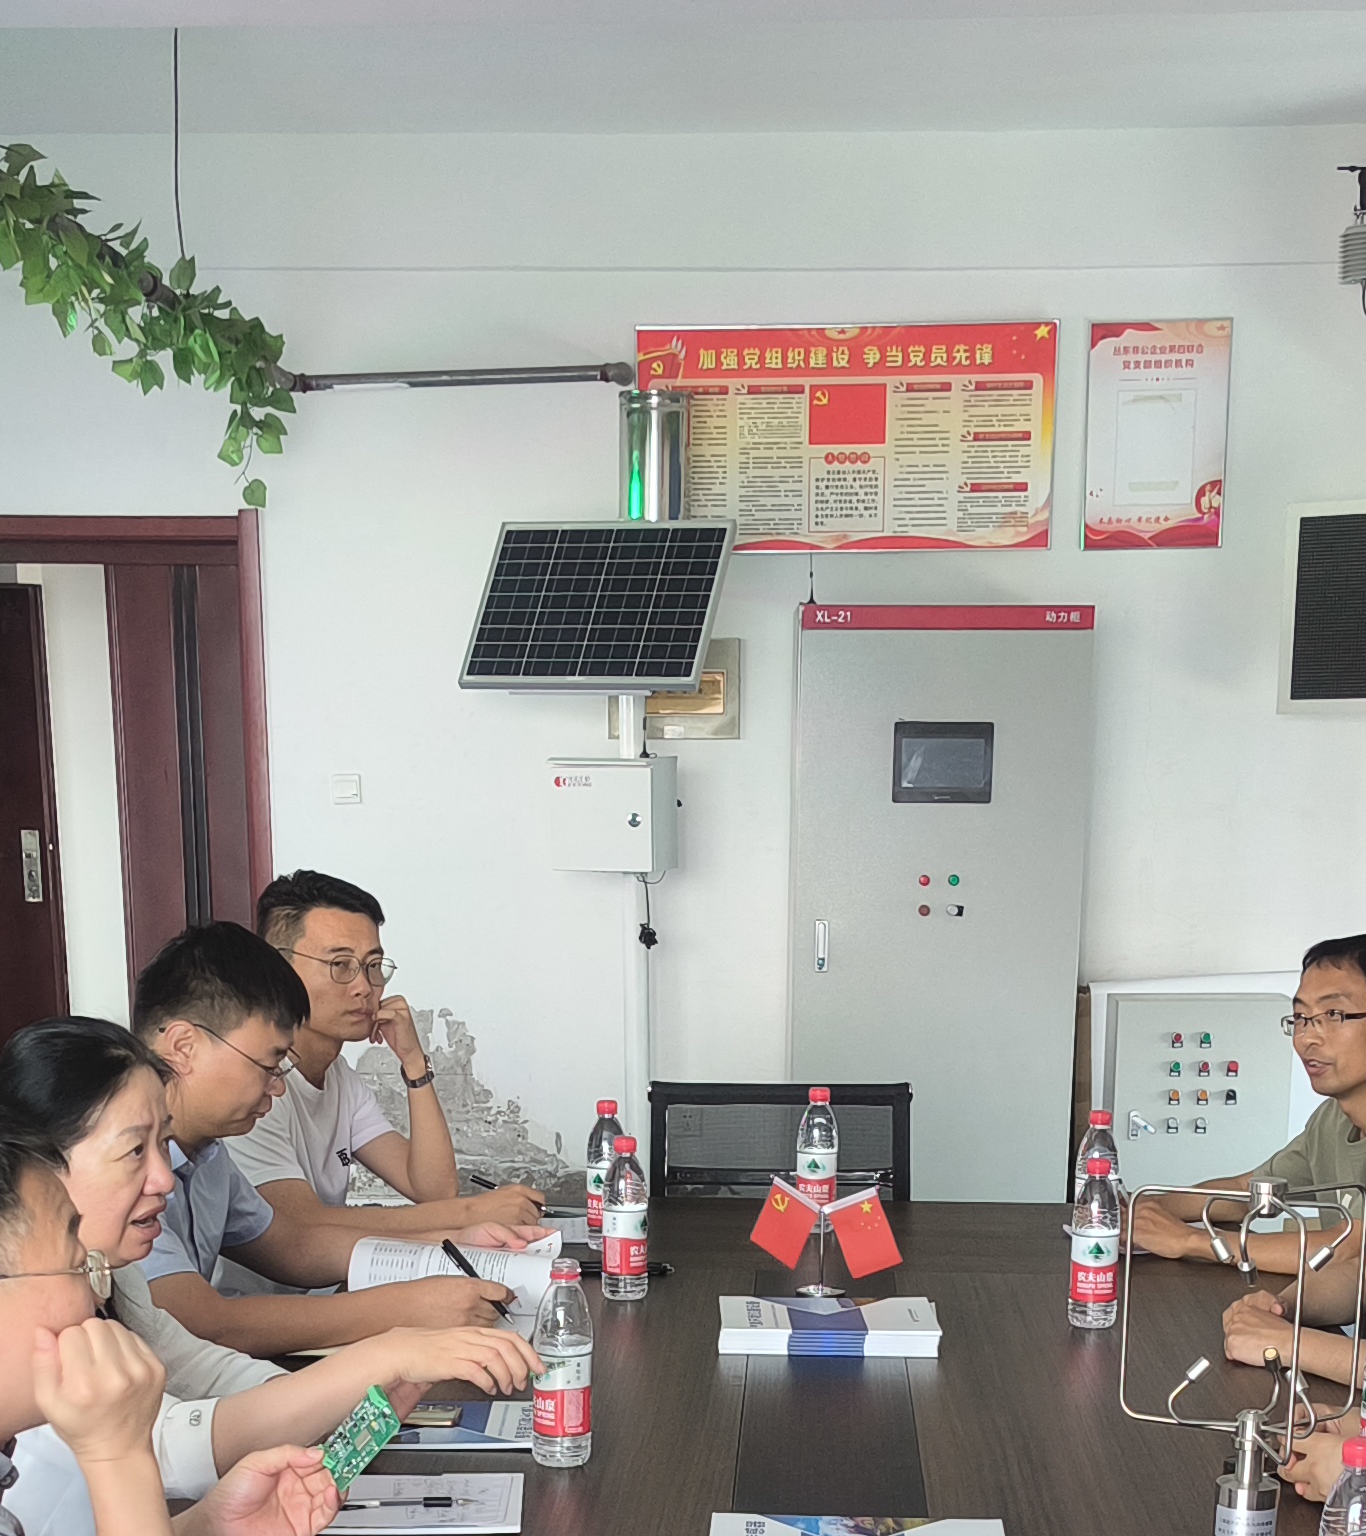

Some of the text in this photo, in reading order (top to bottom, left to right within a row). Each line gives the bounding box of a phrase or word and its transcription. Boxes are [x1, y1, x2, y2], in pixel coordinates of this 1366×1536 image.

[698, 344, 994, 371] 加强党组织建设 争当党员先锋
[815, 610, 852, 623] XL-21
